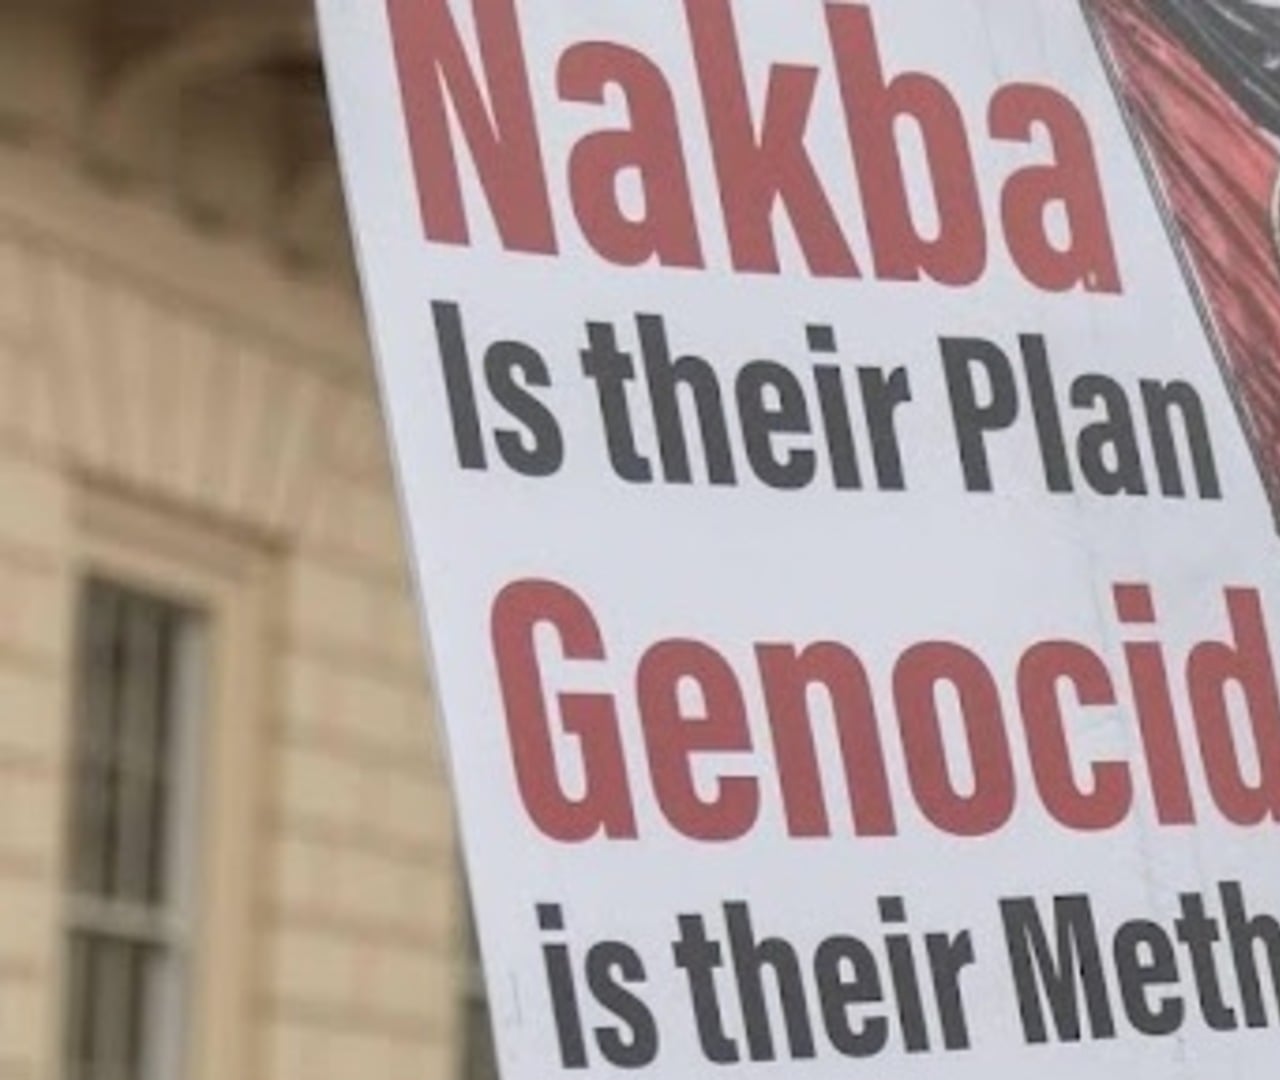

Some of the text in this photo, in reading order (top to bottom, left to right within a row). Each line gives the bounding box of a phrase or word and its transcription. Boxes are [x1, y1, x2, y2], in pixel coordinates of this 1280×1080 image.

[388, 0, 1124, 296] Nakba
[429, 300, 1224, 500] Is their Plan
[535, 902, 660, 1070] is
[672, 896, 975, 1064] their
